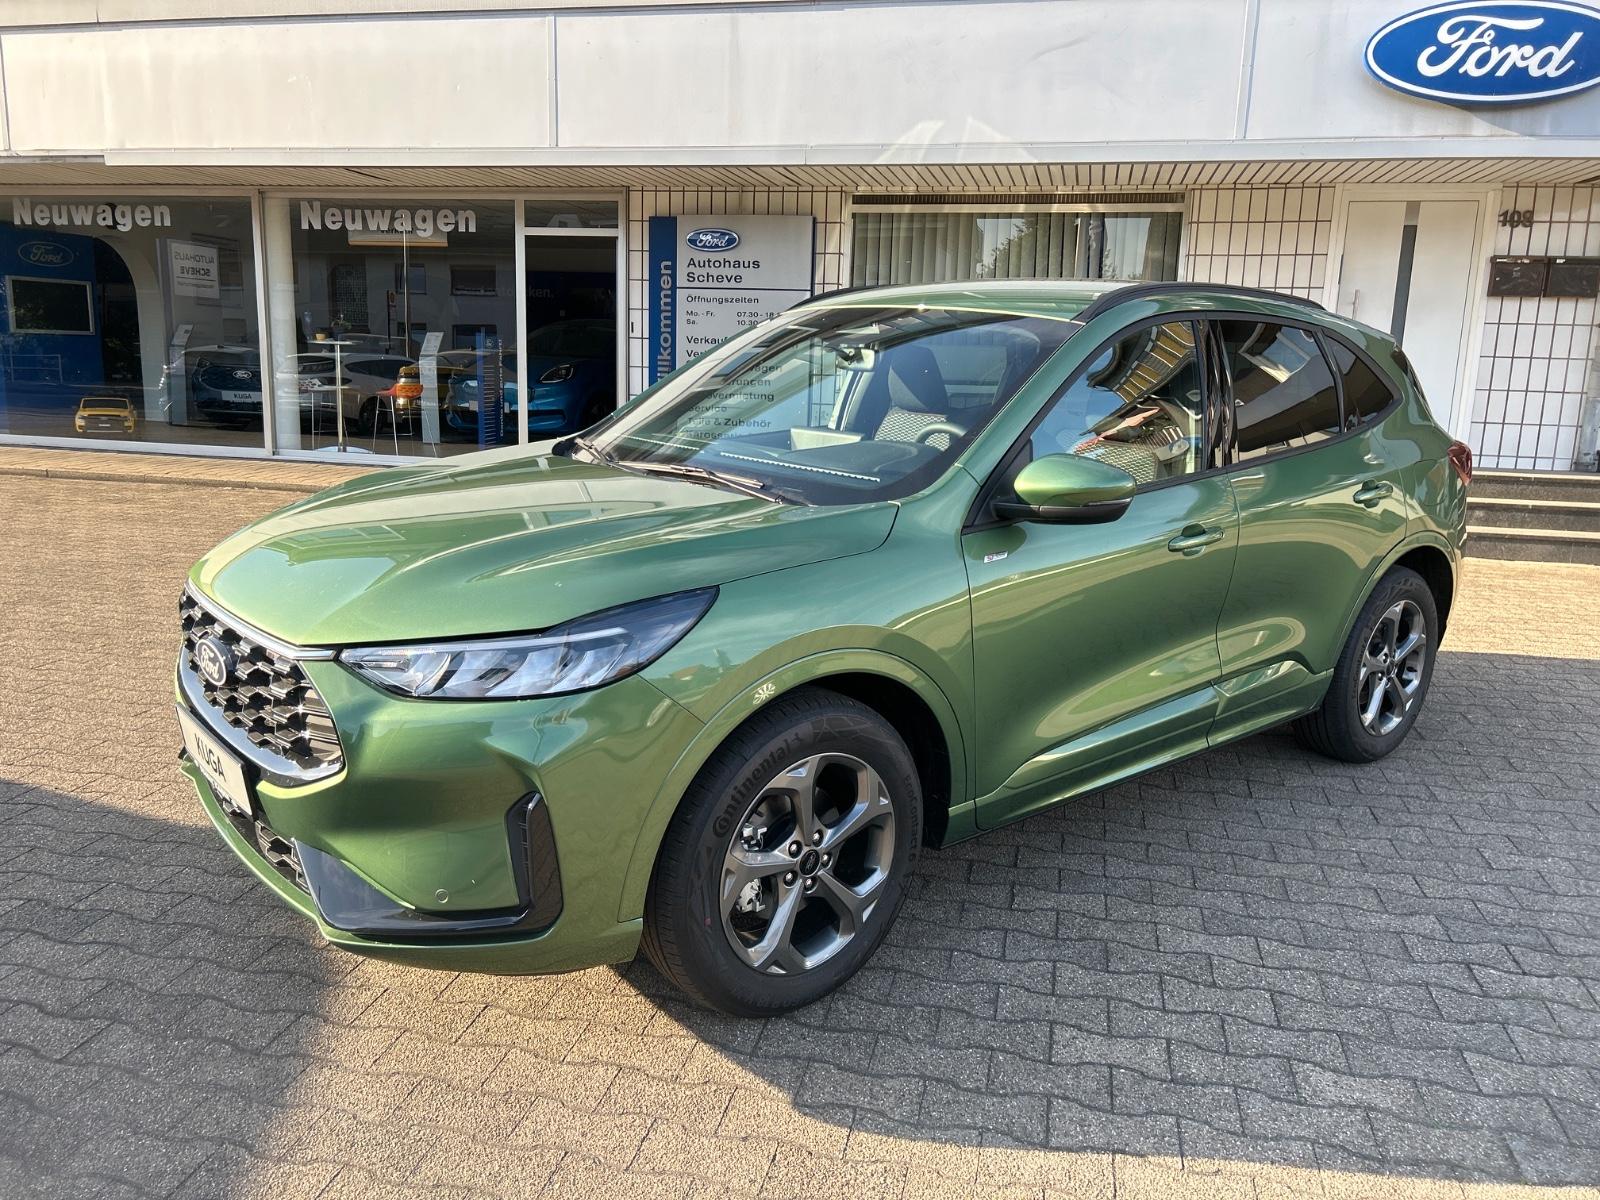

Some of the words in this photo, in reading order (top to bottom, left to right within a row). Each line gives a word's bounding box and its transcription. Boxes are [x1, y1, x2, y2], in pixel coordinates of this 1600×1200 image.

[1417, 15, 1584, 77] Ford
[12, 198, 171, 232] Neuwagen
[300, 200, 477, 238] Neuwagen
[30, 244, 64, 264] Ford
[697, 231, 729, 248] Ford
[687, 257, 761, 269] Autohaus
[687, 272, 743, 283] Scheve
[686, 294, 759, 304] Öffnungszeiten
[657, 260, 673, 382] illkommen
[200, 643, 220, 680] Ford
[194, 732, 227, 783] KUGA
[713, 738, 791, 838] Continental
